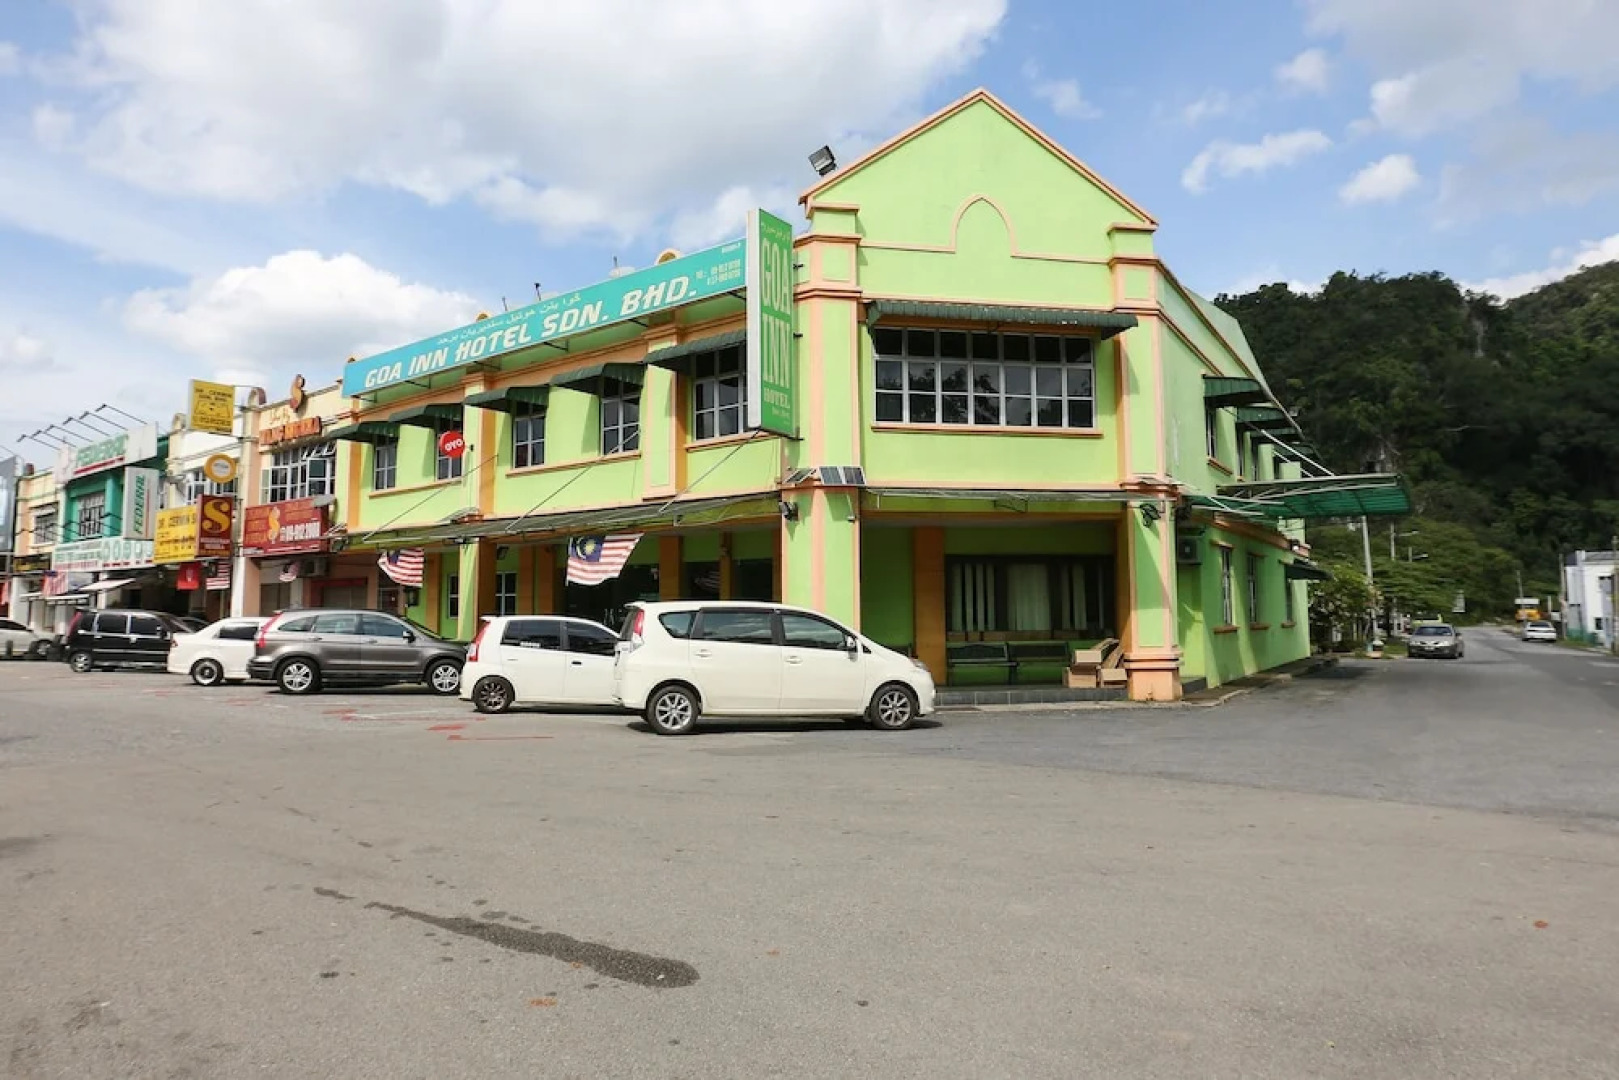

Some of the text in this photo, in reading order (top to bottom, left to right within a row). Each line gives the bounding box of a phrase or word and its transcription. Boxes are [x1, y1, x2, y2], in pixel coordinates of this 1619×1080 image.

[762, 237, 791, 315] GOA
[365, 276, 697, 388] GOA INN HOTEL SDN. BHD.
[762, 313, 791, 389] INN
[444, 438, 464, 452] OYO
[202, 499, 231, 534] S
